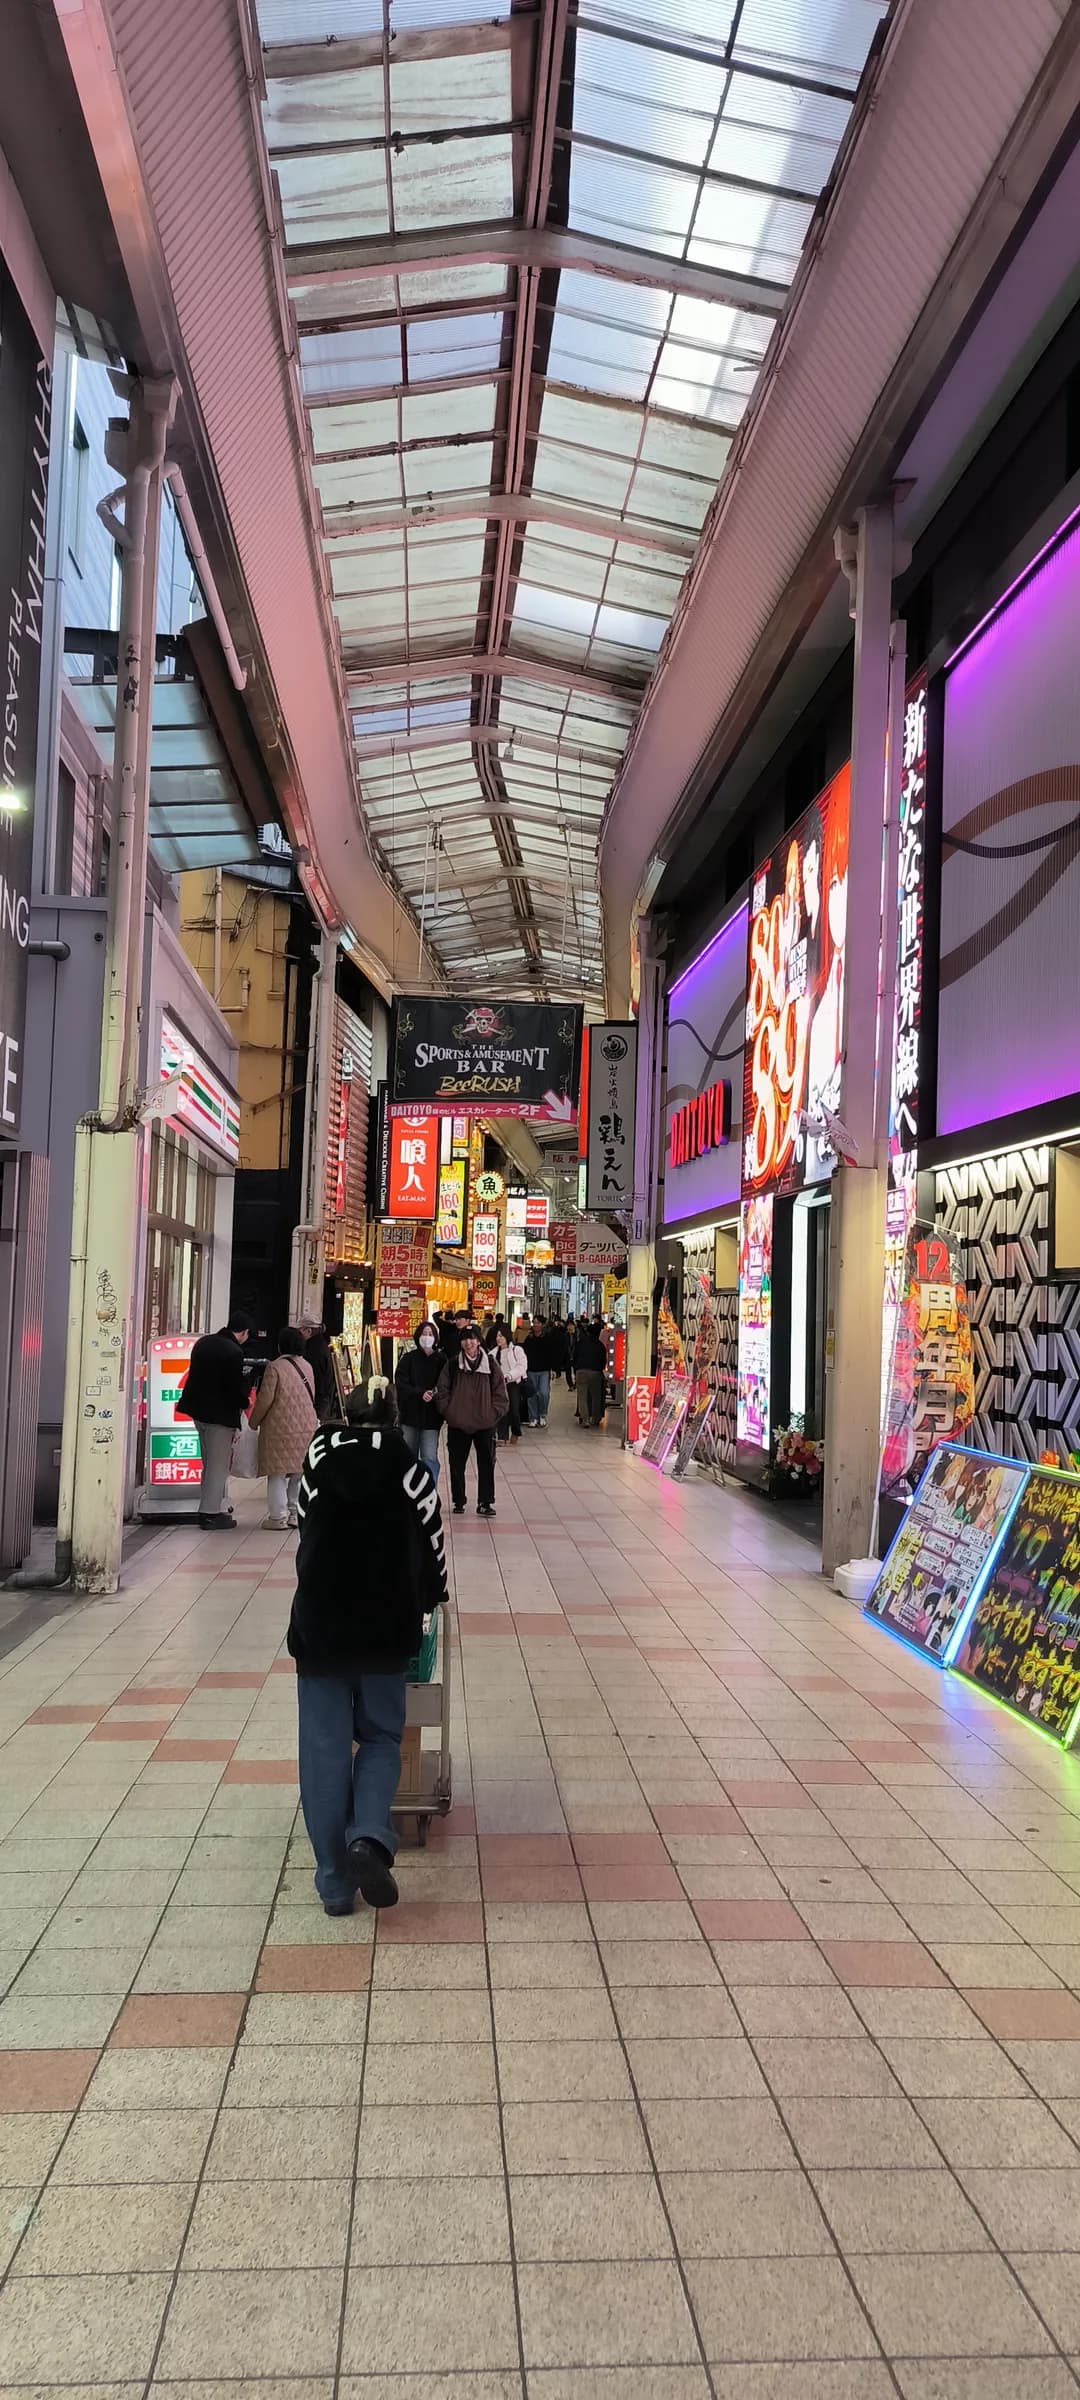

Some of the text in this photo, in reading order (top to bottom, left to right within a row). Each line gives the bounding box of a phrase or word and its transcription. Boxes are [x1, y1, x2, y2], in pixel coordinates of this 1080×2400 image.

[893, 689, 926, 1135] 新たな世界線へ
[457, 1060, 506, 1073] BAR
[473, 1047, 550, 1071] AMUSEMENT
[518, 1104, 541, 1116] 2F
[670, 1079, 727, 1168] DAITOYO
[480, 1176, 498, 1194] 魚
[440, 1193, 459, 1210] 160
[439, 1224, 458, 1241] 100
[477, 1222, 494, 1232] 生中
[475, 1233, 495, 1246] 180
[556, 1241, 575, 1250] BIG
[580, 1242, 623, 1252] ダーツバー
[474, 1254, 494, 1268] 150
[913, 1240, 949, 1278] 12
[476, 1281, 494, 1289] 800
[637, 1385, 650, 1441] スロット
[170, 1436, 198, 1457] 酒
